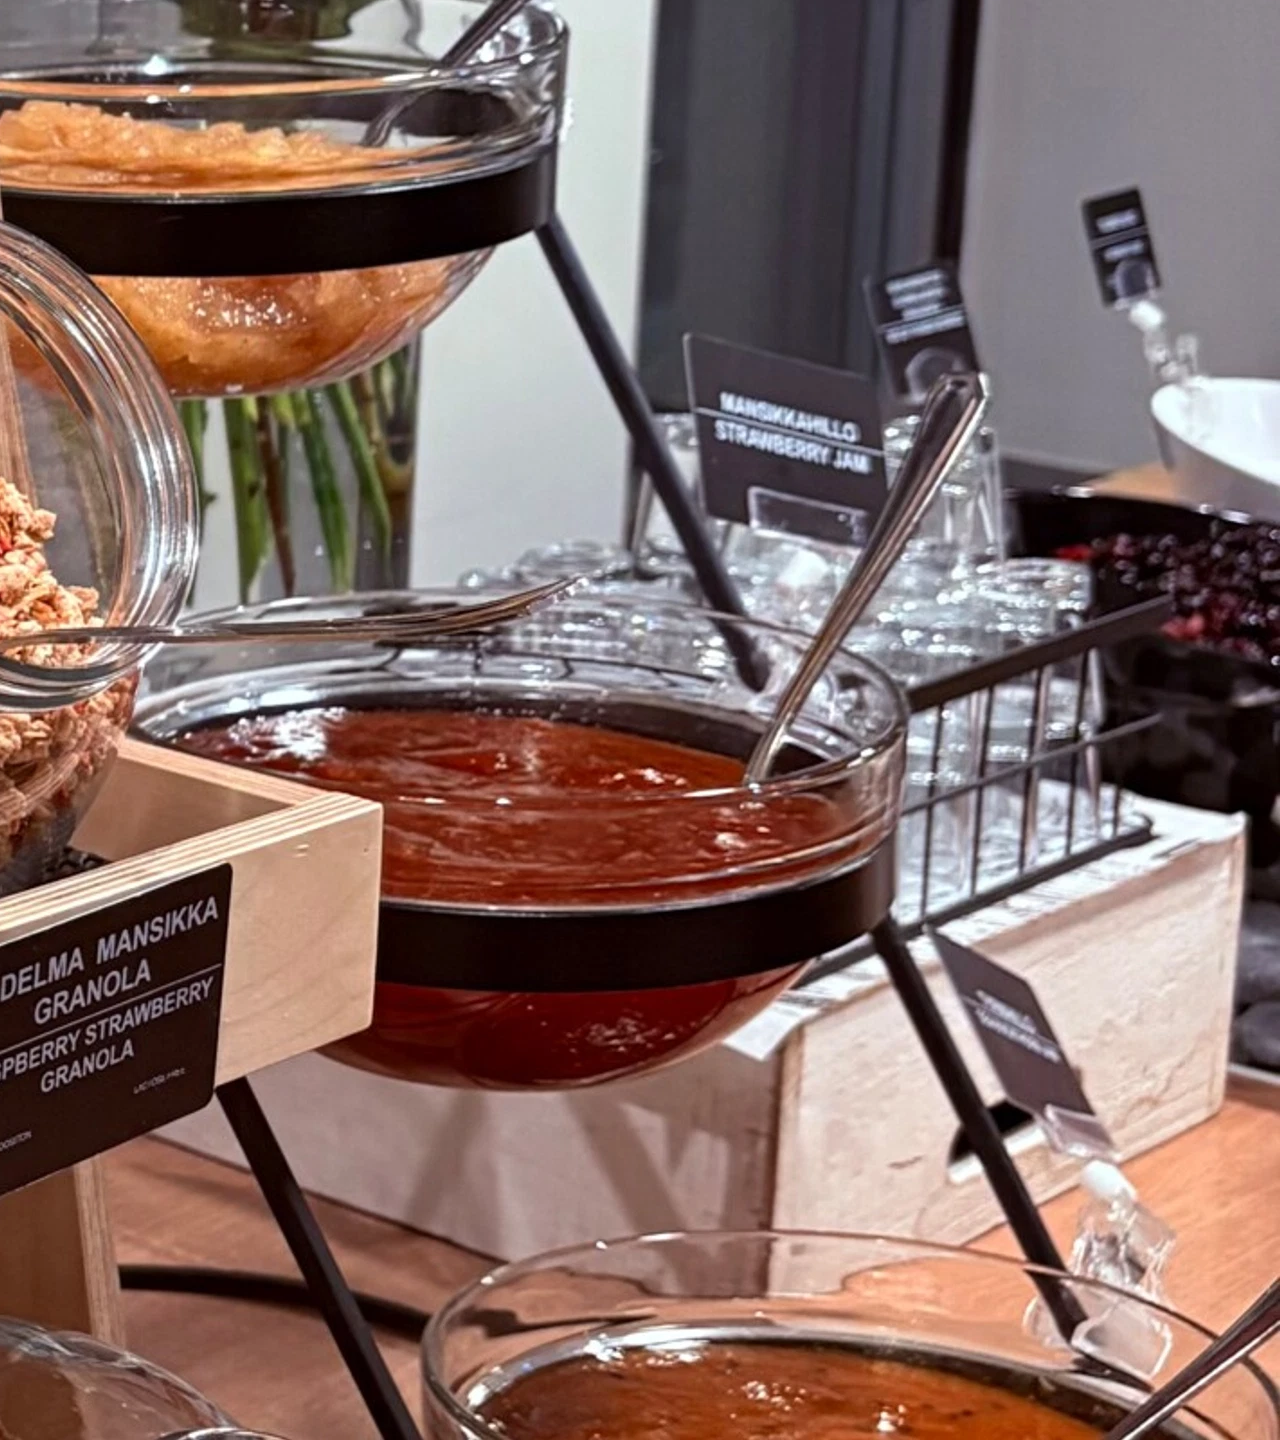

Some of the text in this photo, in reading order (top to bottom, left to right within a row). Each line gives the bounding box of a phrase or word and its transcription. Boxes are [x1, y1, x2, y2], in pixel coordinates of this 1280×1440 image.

[715, 419, 872, 474] STRAWBERRY JAM
[720, 391, 861, 443] MANSIKKAHILLO
[96, 896, 219, 965] MANSIKKA
[33, 959, 151, 1025] GRANOLA
[85, 976, 214, 1046] STRAWBERRY
[40, 1039, 135, 1093] GRANOLA
